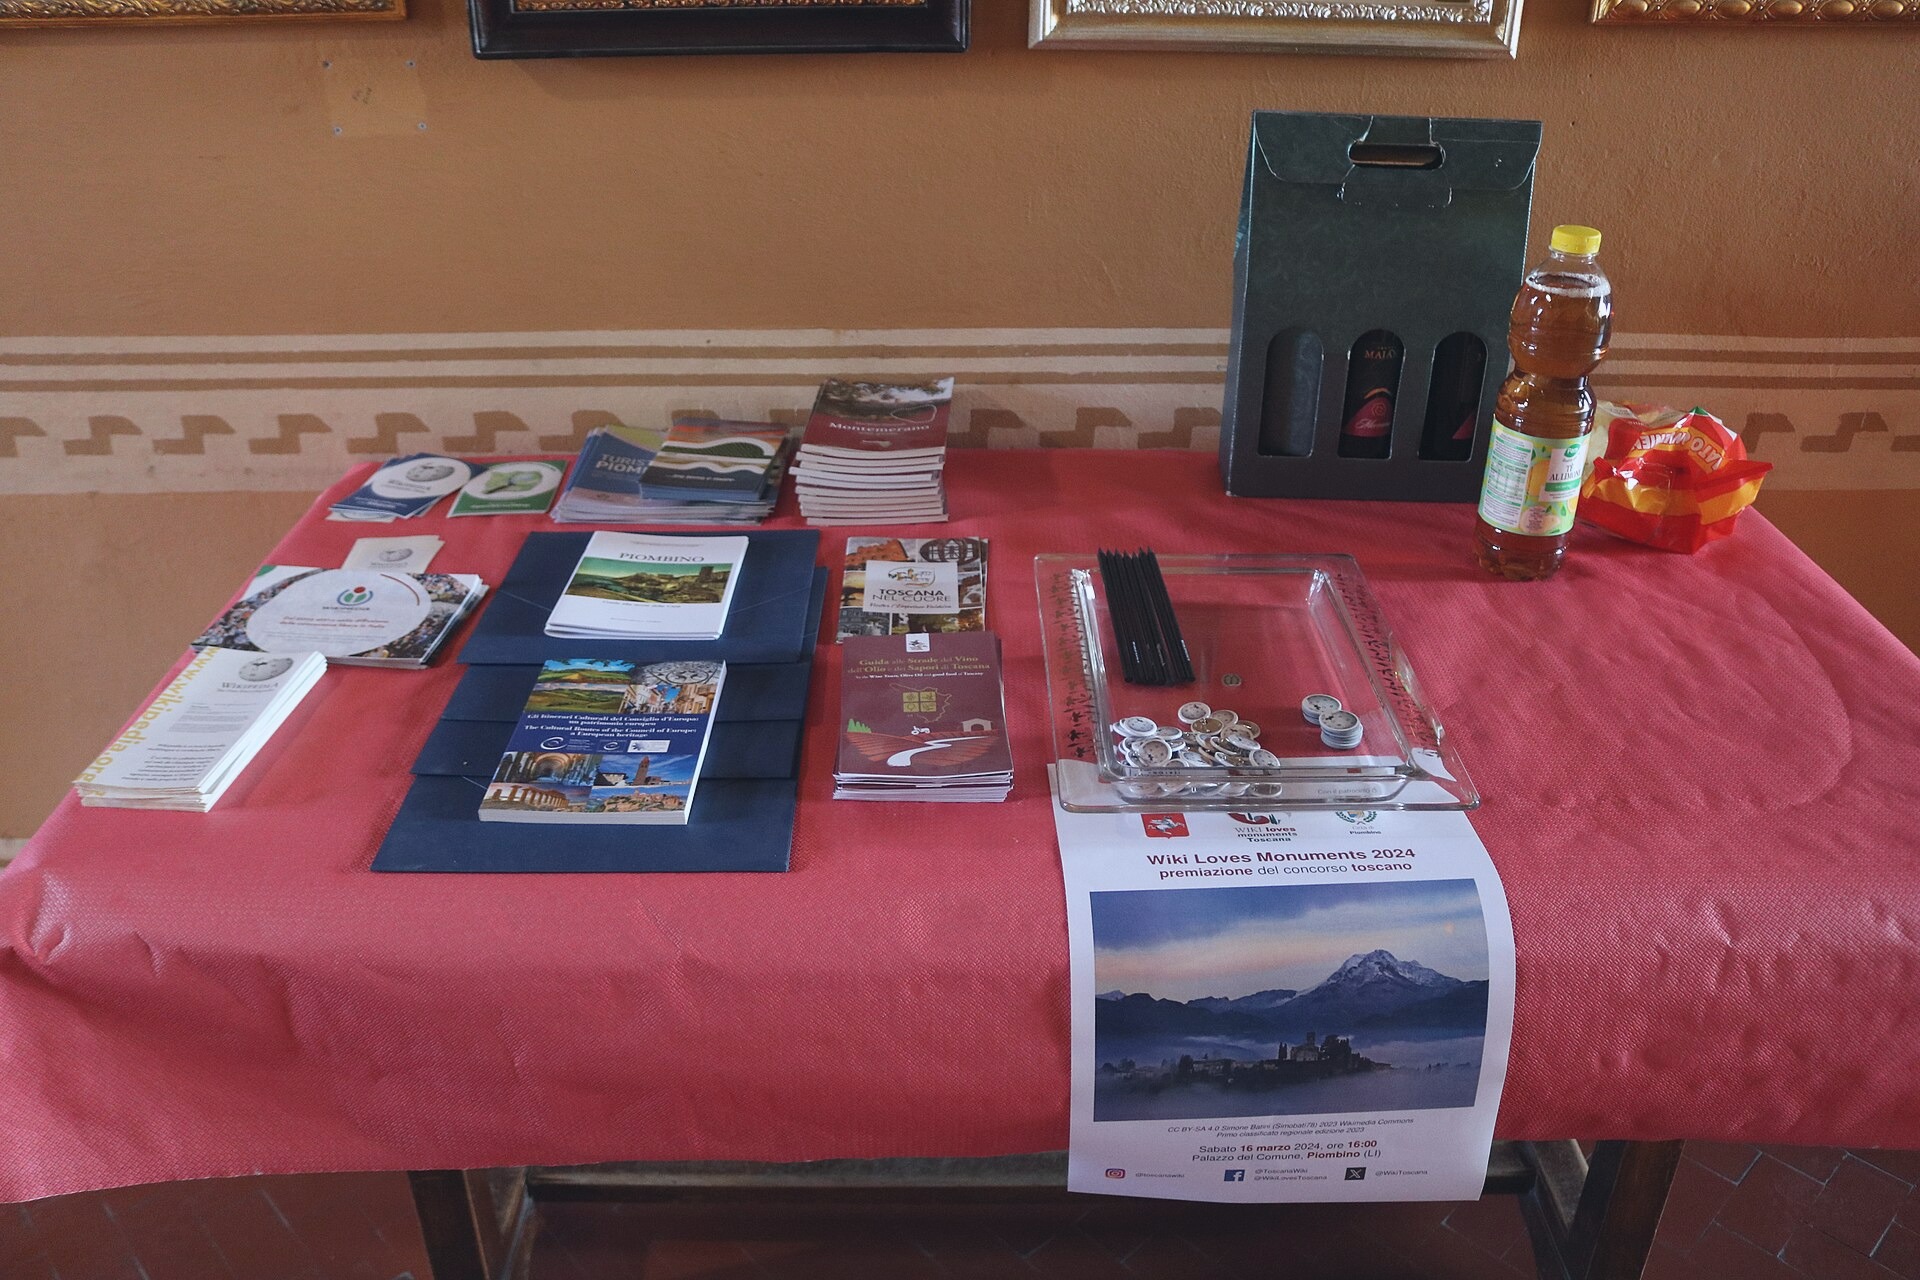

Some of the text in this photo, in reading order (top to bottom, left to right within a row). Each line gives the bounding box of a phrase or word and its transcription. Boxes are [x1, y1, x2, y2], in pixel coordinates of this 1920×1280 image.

[619, 552, 705, 562] PIOMBINO
[880, 588, 944, 596] TOSCANA
[872, 594, 897, 602] NEL
[1147, 848, 1416, 865] Wiki Loves Monuments 2024
[1159, 862, 1412, 880] premiazione del concorso toscano
[1339, 1119, 1376, 1127] Wikimedia
[1314, 1127, 1345, 1135] edizione
[1346, 1126, 1365, 1134] 2023
[1199, 1145, 1237, 1153] Sabato
[1240, 1144, 1253, 1152] 16
[1294, 1142, 1323, 1151] 2024,
[1347, 1140, 1378, 1149] 16:00
[1192, 1149, 1382, 1162] Palazzo del Comune, Piombino (LI)
